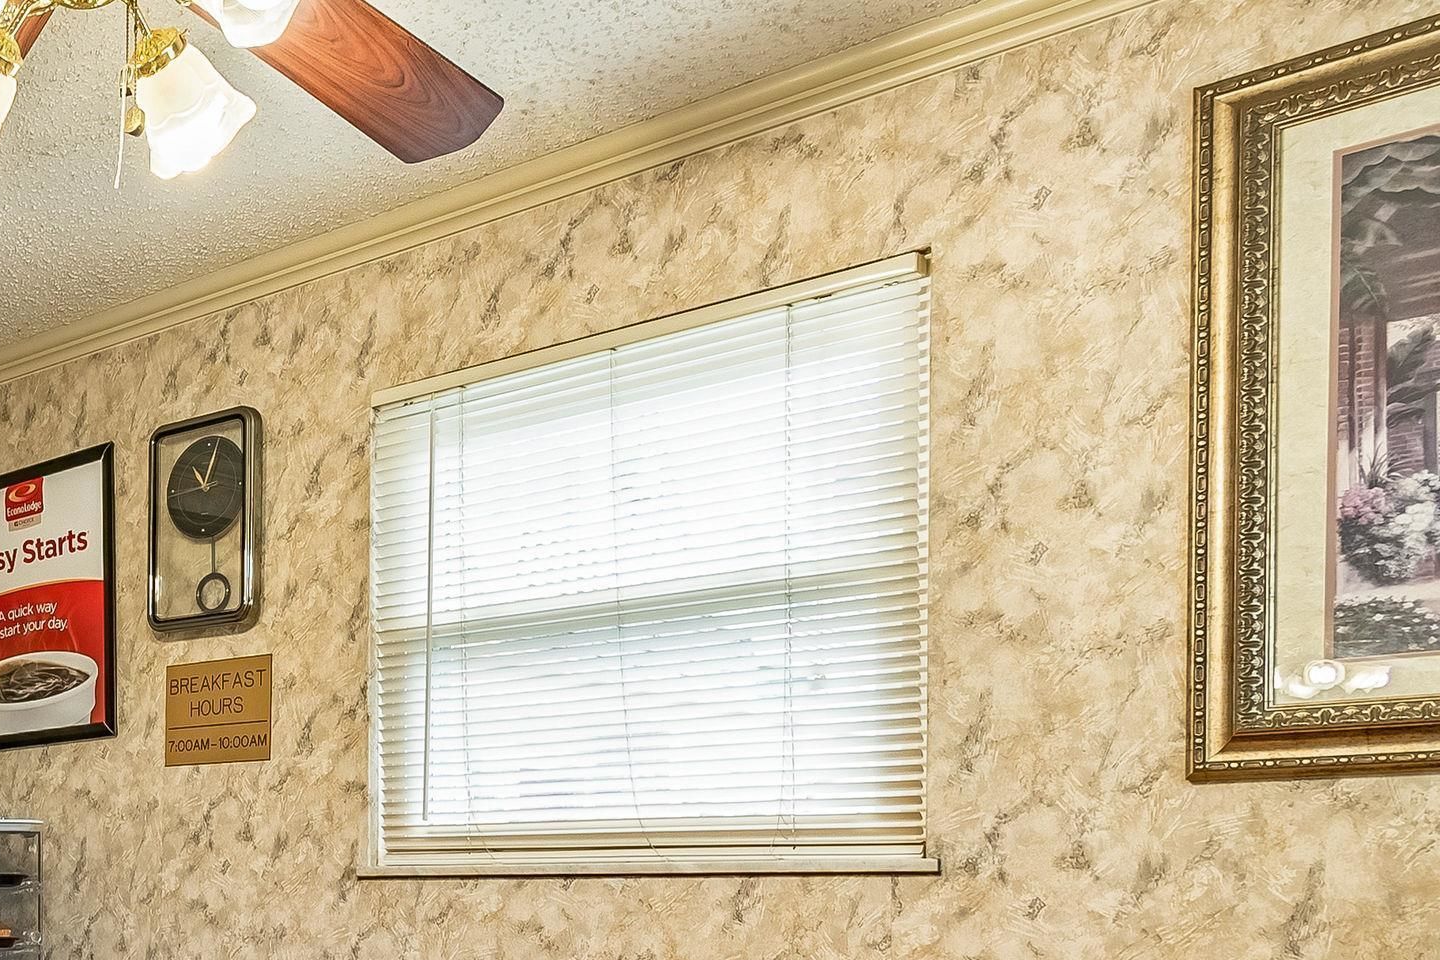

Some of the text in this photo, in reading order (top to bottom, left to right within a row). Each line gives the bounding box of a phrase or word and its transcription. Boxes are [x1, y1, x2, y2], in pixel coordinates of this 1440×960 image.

[23, 530, 88, 564] Starts
[7, 603, 34, 621] quick
[36, 602, 58, 615] way
[0, 623, 21, 639] start
[22, 619, 47, 636] your
[47, 616, 68, 631] day.
[169, 669, 267, 695] BREAKFAST
[190, 696, 244, 717] HOURS
